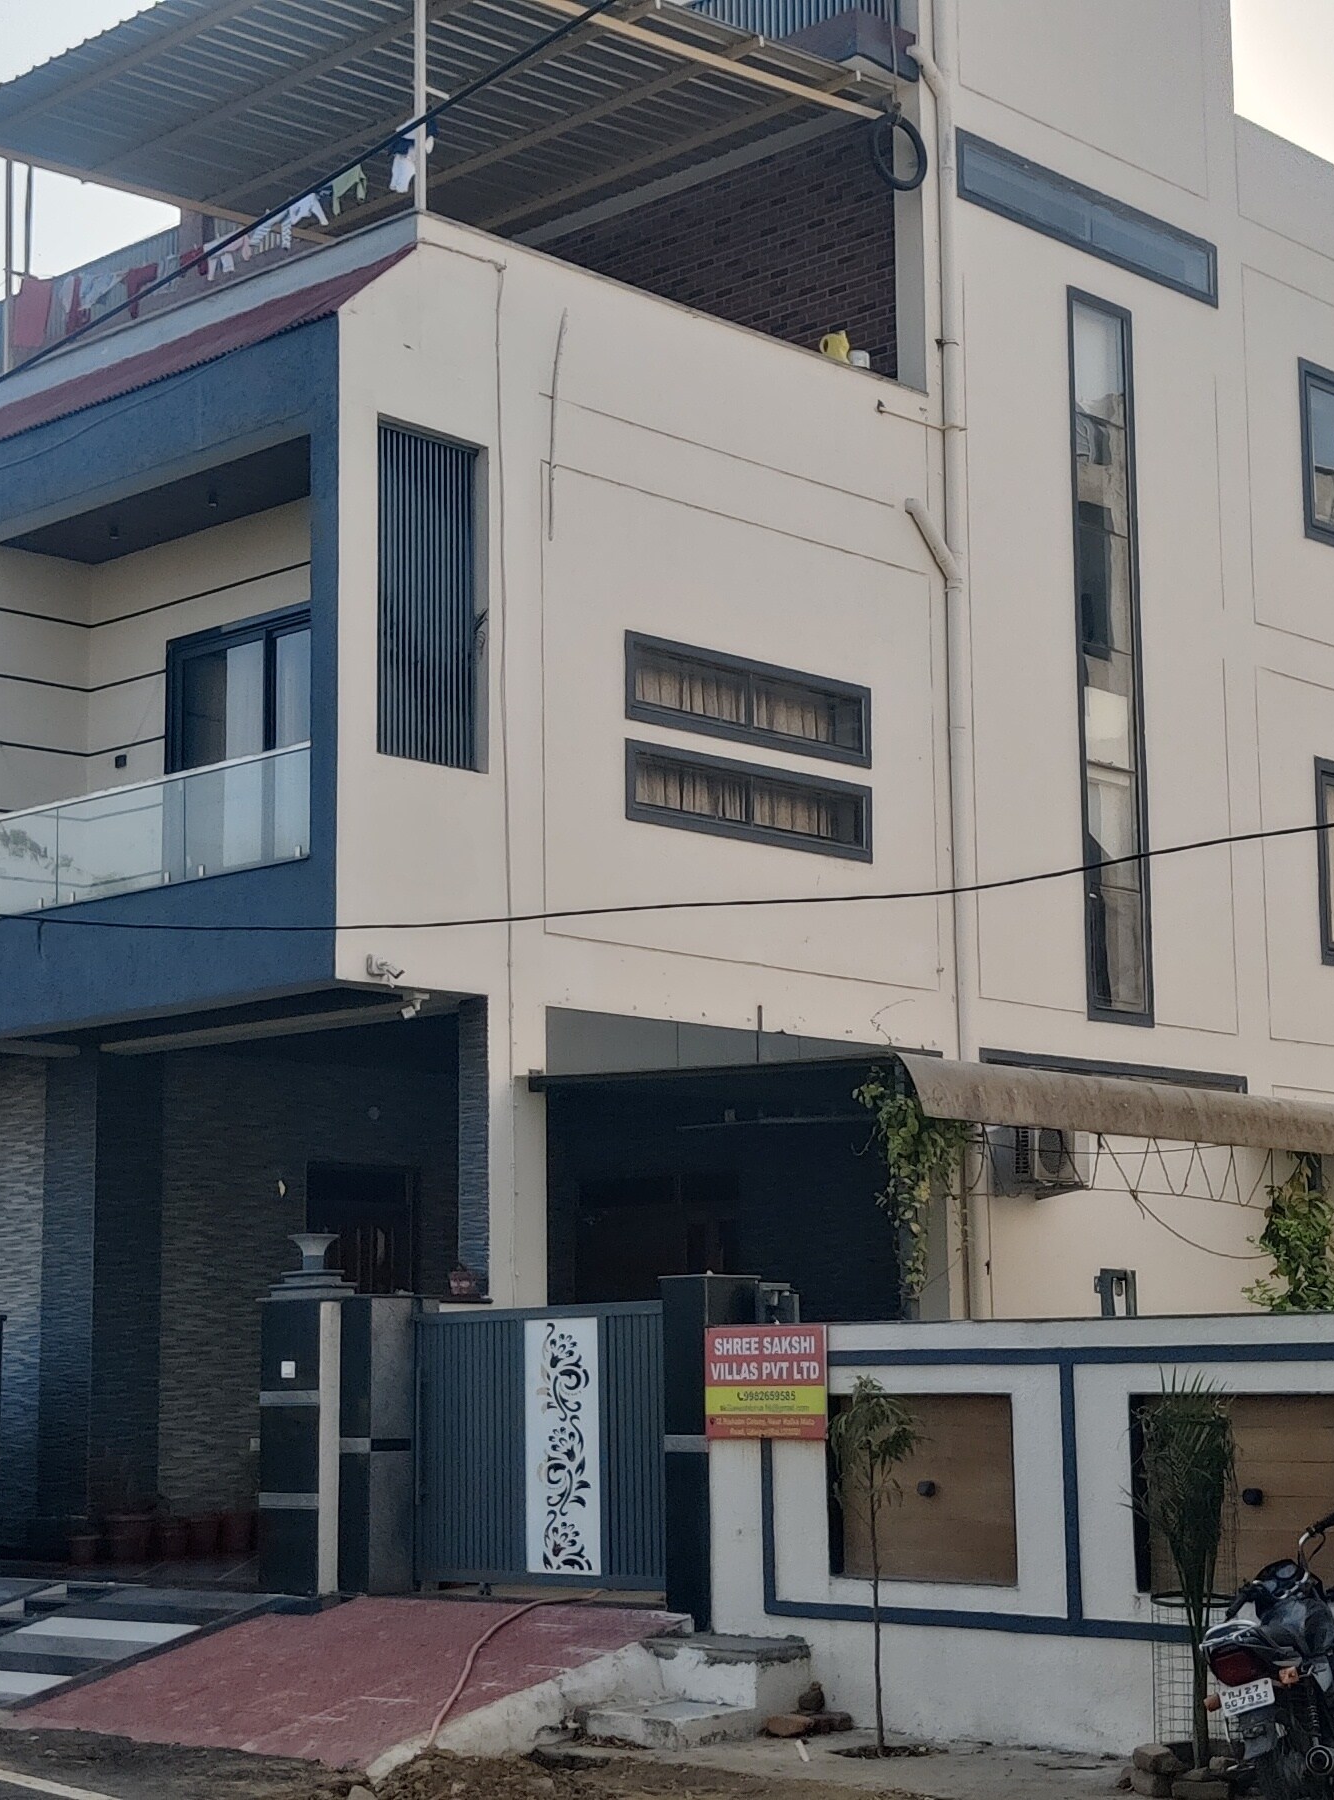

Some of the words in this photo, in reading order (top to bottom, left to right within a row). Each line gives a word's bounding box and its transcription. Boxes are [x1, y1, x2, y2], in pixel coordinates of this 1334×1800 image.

[714, 1337, 760, 1355] SHREE
[763, 1336, 815, 1354] SAKSHI
[711, 1362, 758, 1380] VILLAS
[762, 1361, 789, 1380] PVT
[793, 1361, 819, 1380] LTD
[1244, 1684, 1259, 1694] 27
